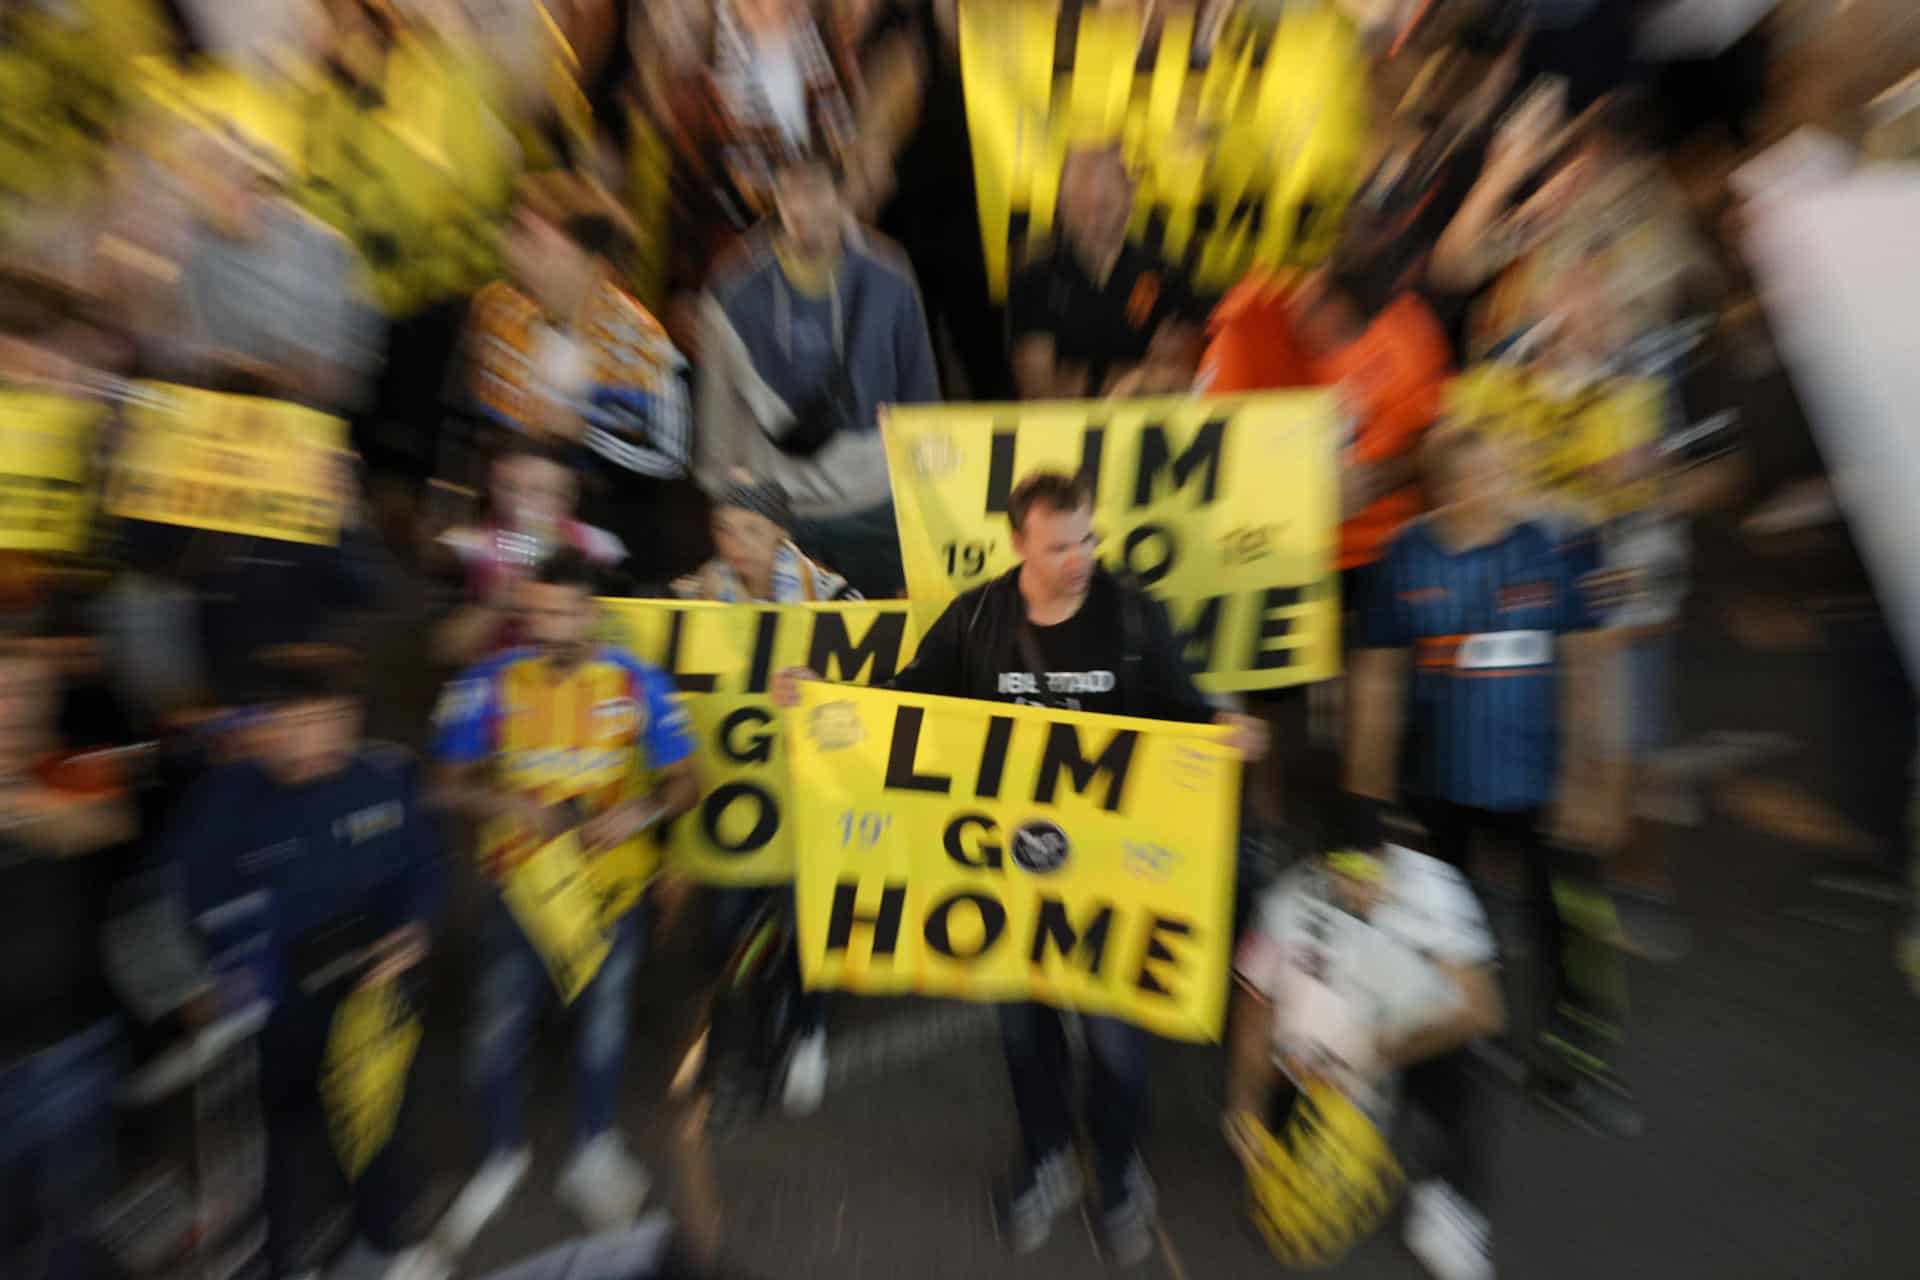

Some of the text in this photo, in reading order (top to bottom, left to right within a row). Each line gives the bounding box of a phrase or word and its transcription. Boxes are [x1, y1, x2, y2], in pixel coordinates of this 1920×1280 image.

[985, 418, 1226, 513] LIM
[664, 609, 907, 694] LIM
[884, 704, 1142, 812] LIM
[824, 882, 1193, 1000] HOME
